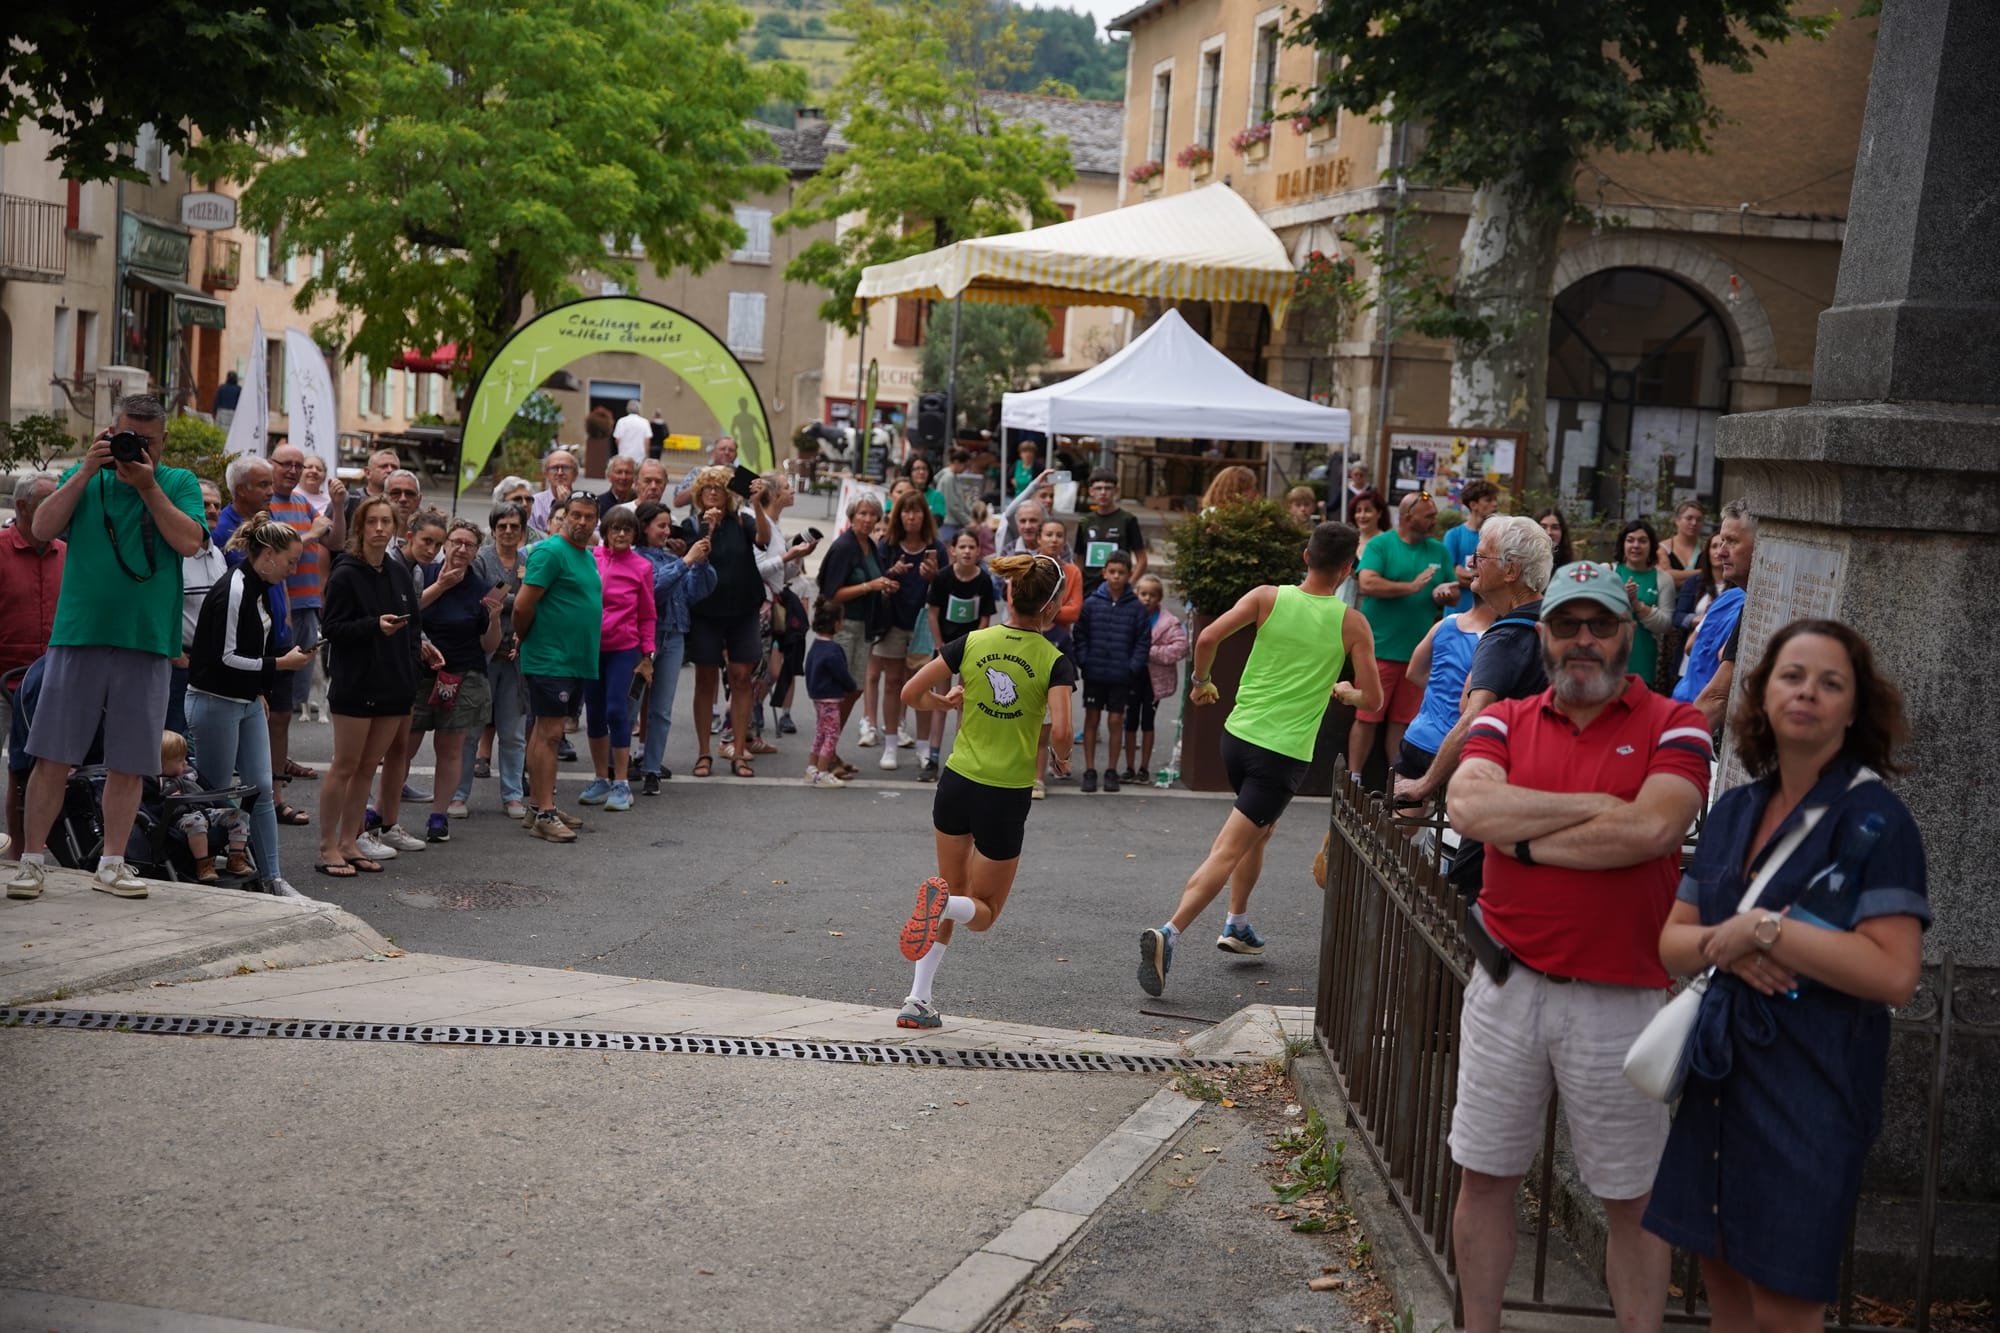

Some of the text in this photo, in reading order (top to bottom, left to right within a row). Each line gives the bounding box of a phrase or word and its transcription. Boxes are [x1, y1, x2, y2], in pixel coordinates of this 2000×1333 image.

[1276, 157, 1350, 201] MAIRIE
[187, 202, 229, 222] PIZZERIA
[568, 313, 674, 333] Challenge des
[559, 327, 610, 341] vallées
[1096, 549, 1105, 561] 3
[958, 606, 967, 617] 2
[1003, 653, 1036, 679] MENDOIS
[977, 702, 1024, 719] ATHLÉTISME
